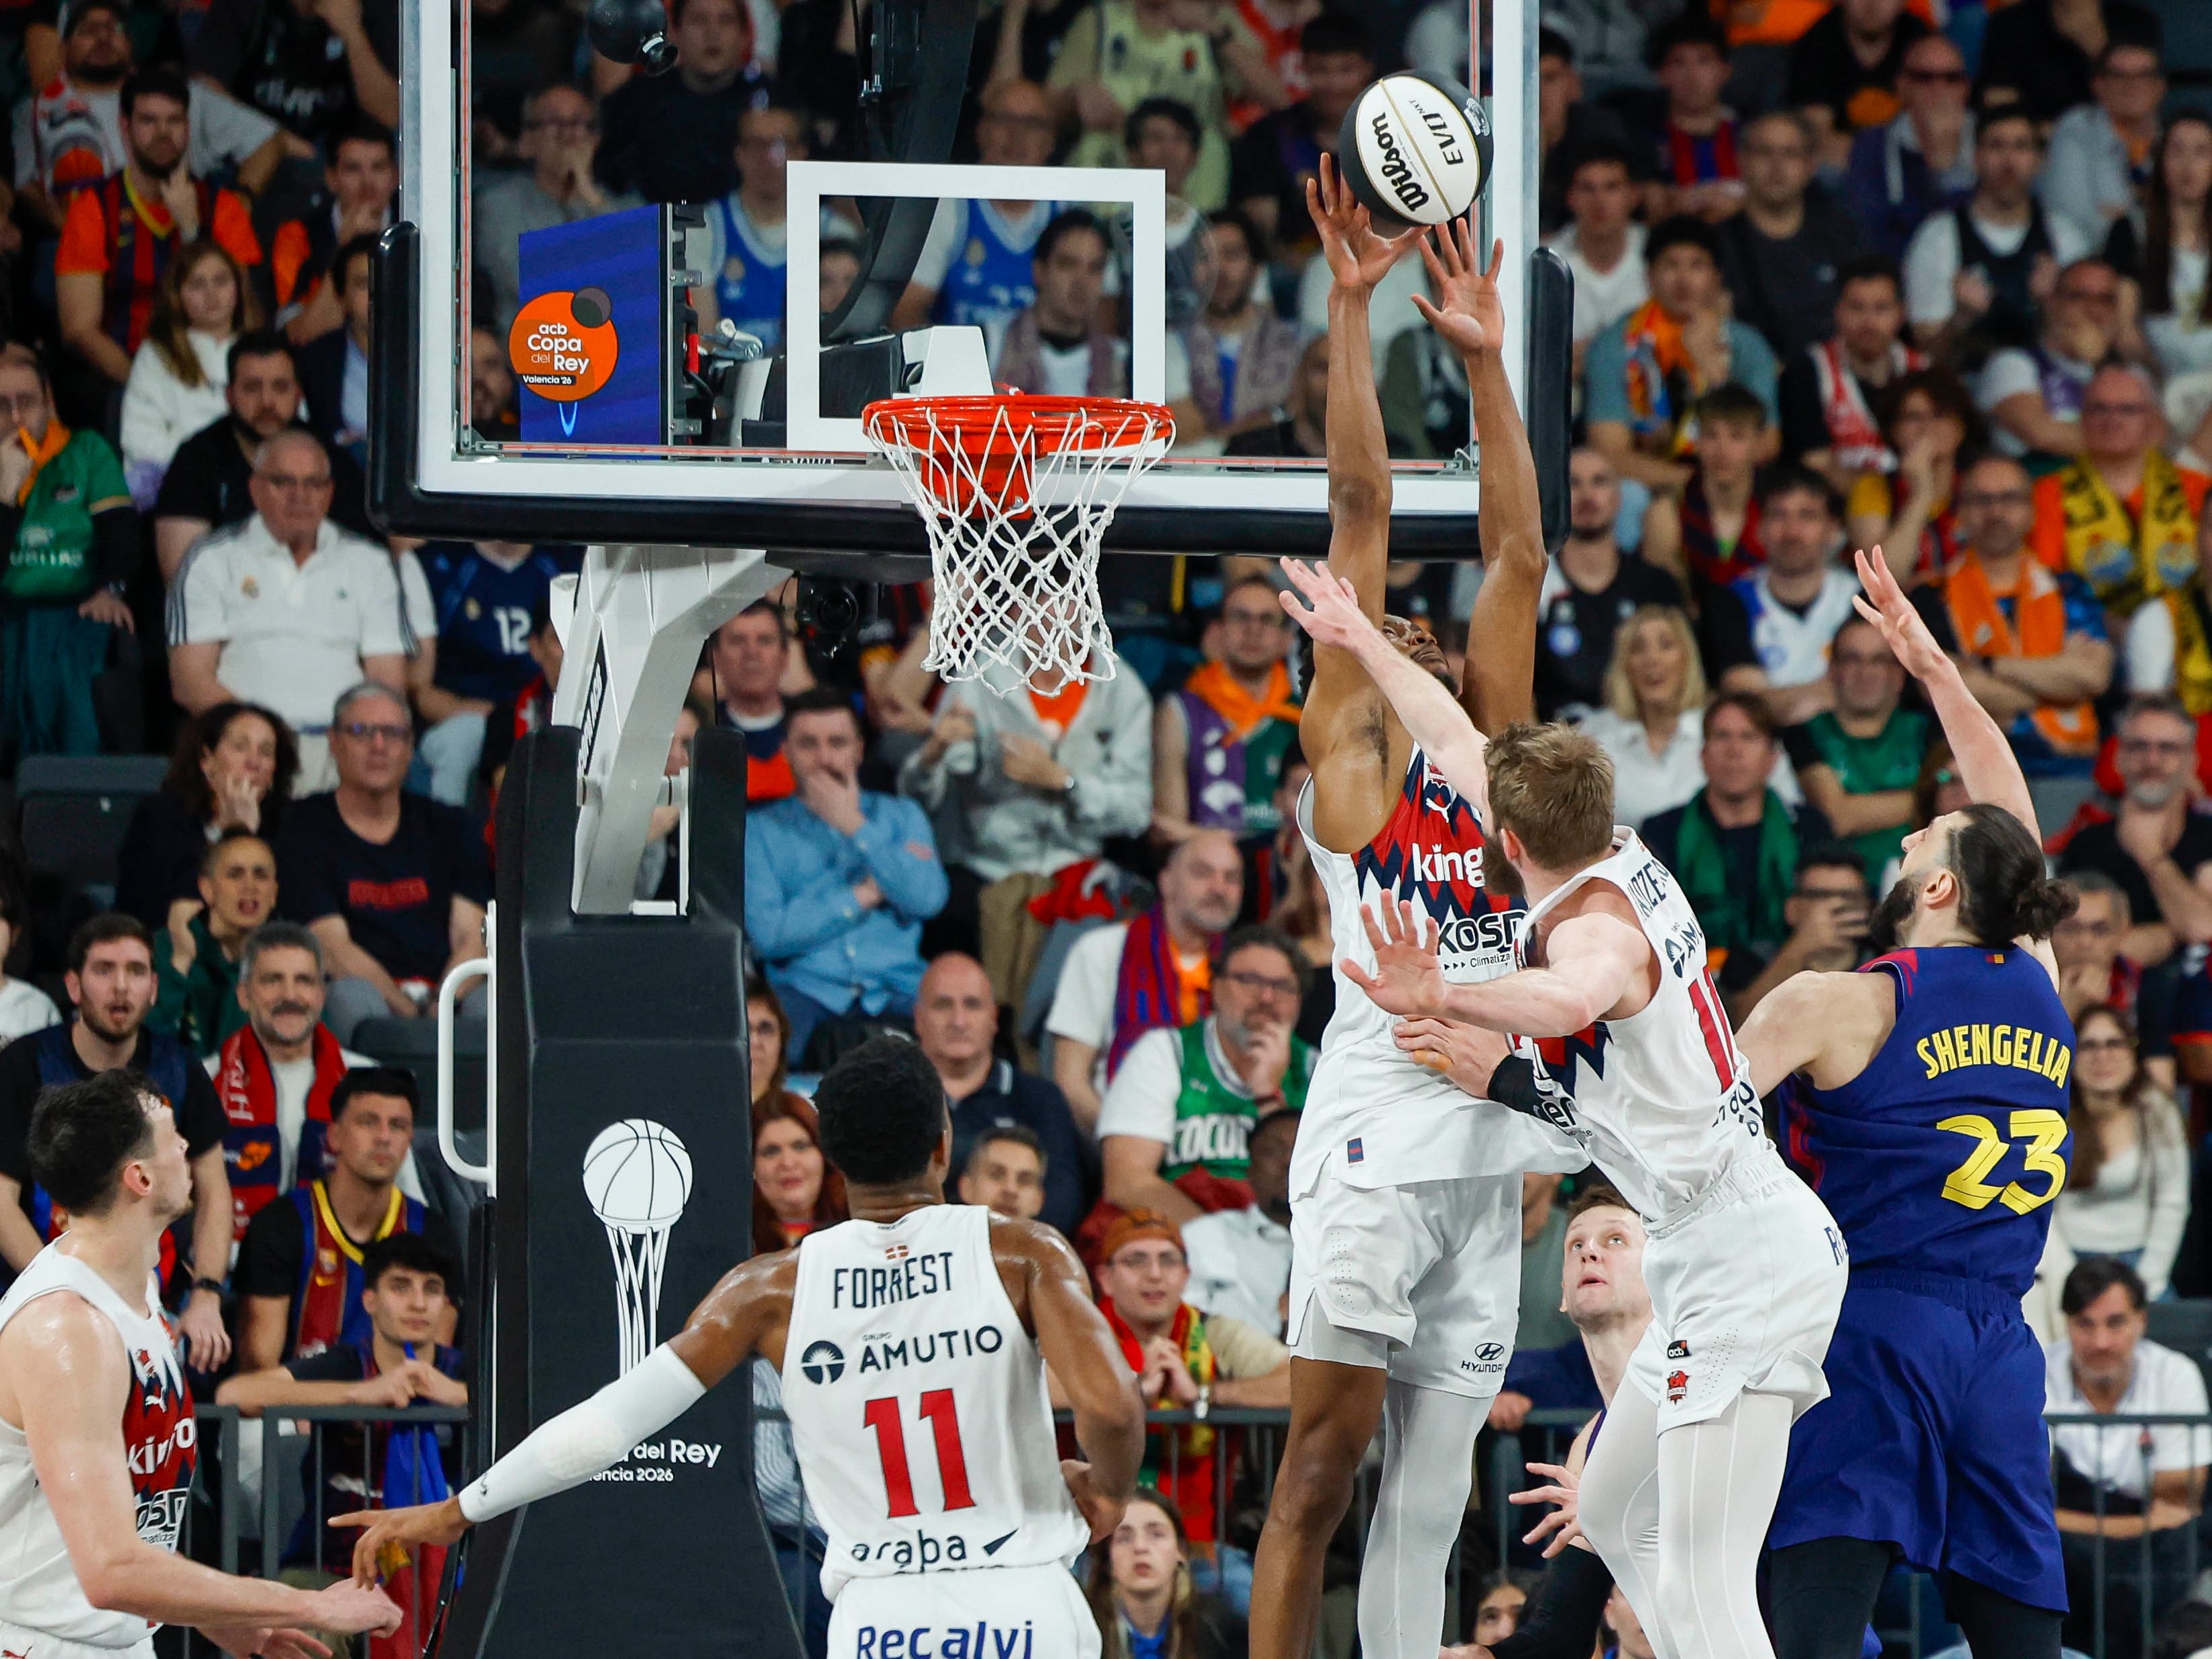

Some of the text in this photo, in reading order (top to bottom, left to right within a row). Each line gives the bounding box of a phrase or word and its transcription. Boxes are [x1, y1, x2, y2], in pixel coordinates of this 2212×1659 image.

[1373, 112, 1430, 212] Wilson
[528, 334, 582, 354] Copa
[538, 323, 568, 335] acb
[522, 375, 560, 385] Valencia
[531, 353, 590, 375] del Rey
[493, 606, 531, 654] 12
[1916, 1023, 2071, 1090] SHENGELIA
[1936, 1108, 2069, 1216] 23
[833, 1251, 953, 1309] FORREST
[860, 1325, 1003, 1373] AMUTIO
[1668, 1346, 1685, 1357] acb
[633, 1442, 665, 1460] del
[670, 1438, 722, 1469] Rey
[863, 1387, 978, 1520] 11
[636, 1467, 674, 1482] 2026
[851, 1529, 967, 1566] araba
[856, 1620, 1033, 1659] Recalvi
